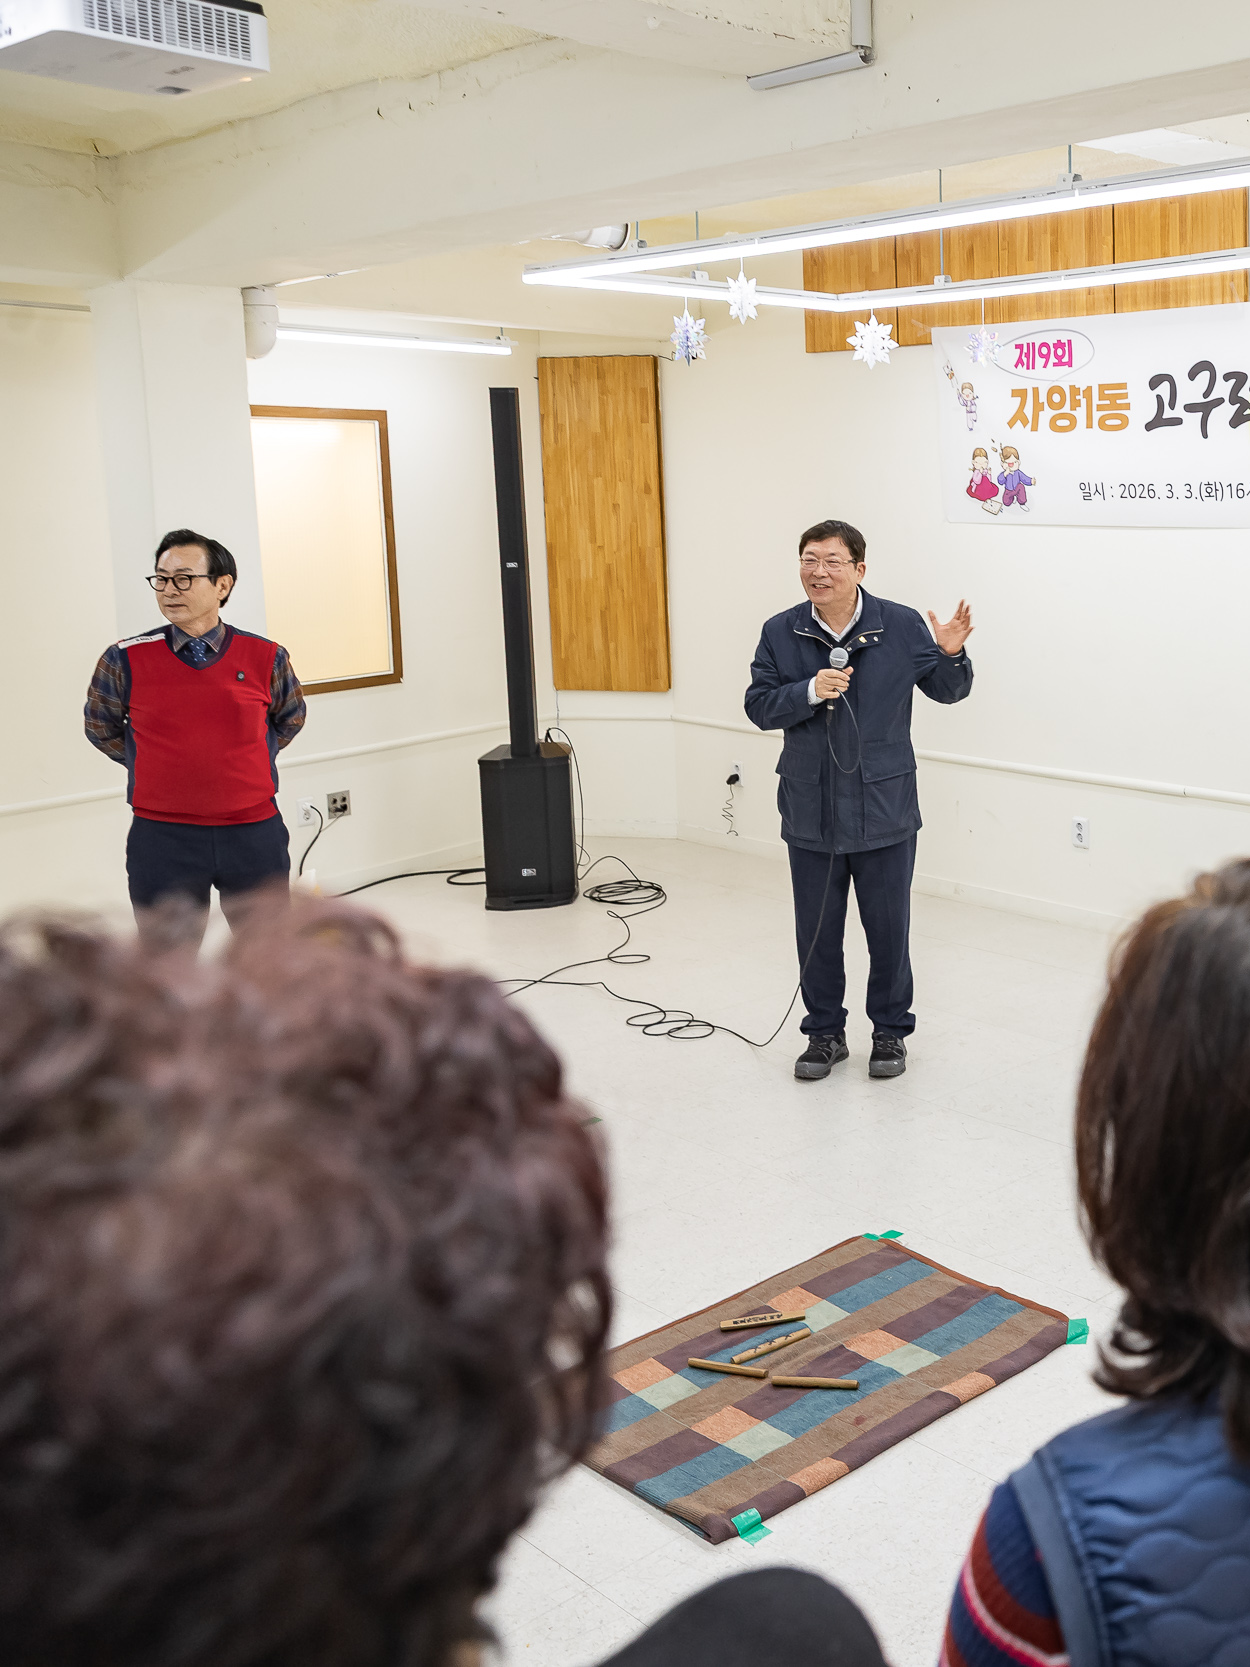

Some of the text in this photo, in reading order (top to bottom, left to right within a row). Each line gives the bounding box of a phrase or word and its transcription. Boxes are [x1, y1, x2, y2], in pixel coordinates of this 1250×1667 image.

[1013, 338, 1074, 371] 제9회
[1006, 382, 1132, 433] 자양1동
[1078, 481, 1107, 501] 일시
[1117, 482, 1161, 500] 2026.
[1165, 482, 1180, 500] 3.
